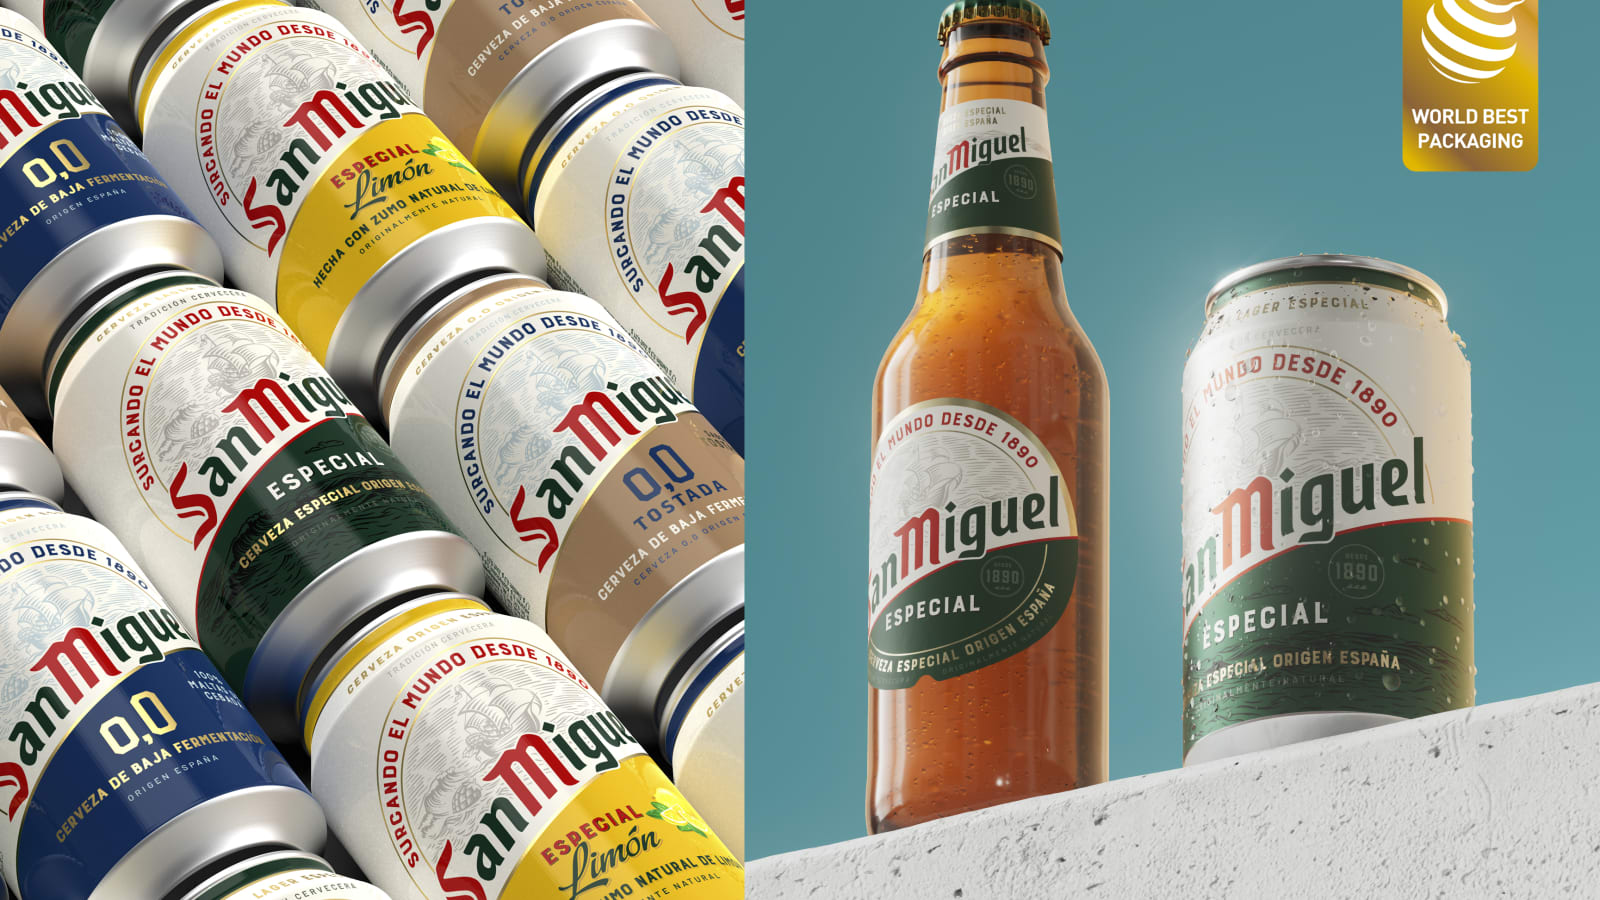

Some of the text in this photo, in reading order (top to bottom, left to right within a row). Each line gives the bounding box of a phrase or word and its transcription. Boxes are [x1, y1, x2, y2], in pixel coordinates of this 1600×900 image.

[217, 30, 273, 75] MUNDO
[277, 24, 336, 40] DESDE
[467, 27, 512, 77] CERVEZA
[512, 15, 530, 31] DE
[205, 82, 223, 100] EL
[22, 138, 91, 188] 0,0
[200, 108, 230, 207] SURCANDO
[330, 143, 420, 190] ESPECIAL
[560, 121, 608, 169] CERVEZA
[29, 200, 49, 217] DE
[49, 182, 86, 204] BAJA
[46, 201, 83, 225] ORIGEN
[86, 188, 127, 203] ESPAÑA
[344, 158, 434, 221] Limón
[610, 109, 743, 293] SURCANDO EL MUNDO DESDE
[931, 190, 1000, 218] ESPECIAL
[312, 248, 345, 289] HECHA
[344, 223, 370, 248] CON
[370, 199, 407, 226] ZUMO
[408, 183, 465, 203] NATURAL
[466, 183, 480, 192] DE
[359, 195, 484, 255] ORIGINALMENTE NATURAL
[96, 302, 151, 343] CERVEZA
[129, 298, 187, 330] TRADICIÓN
[150, 308, 213, 352] MUNDO
[217, 305, 276, 328] DESDE
[464, 312, 511, 345] TRADICIÓN
[541, 314, 602, 331] DESDE
[1236, 296, 1369, 321] LAGER ESPECIAL
[135, 357, 157, 377] EL
[415, 325, 464, 376] CERVEZA
[478, 322, 536, 372] MUNDO
[465, 379, 485, 400] EL
[1202, 355, 1262, 403] MUNDO
[1272, 353, 1347, 385] DESDE
[1350, 379, 1398, 428] 1890
[126, 385, 155, 491] SURCANDO
[460, 408, 494, 515] SURCANDO
[887, 413, 934, 450] MUNDO
[941, 411, 998, 436] DESDE
[1001, 431, 1039, 468] 1890
[266, 451, 385, 501] ESPECIAL
[622, 444, 695, 502] 0,0
[238, 517, 295, 569] CERVEZA
[293, 485, 361, 520] ESPECIAL
[361, 478, 406, 491] ORIGEN
[633, 480, 728, 531] TOSTADA
[30, 543, 97, 561] DESDE
[105, 557, 149, 590] 1890
[597, 548, 649, 601] CERVEZA
[648, 531, 669, 550] DE
[668, 510, 707, 535] BAJA
[633, 547, 678, 586] CERVEZA
[701, 515, 740, 535] ORIGEN
[1335, 562, 1378, 582] 1890
[986, 568, 1020, 585] 1890
[885, 594, 980, 632] ESPECIAL
[896, 650, 960, 673] ESPECIAL
[964, 623, 1017, 656] ORIGEN
[1019, 582, 1056, 627] ESPAÑA
[1203, 601, 1329, 650] ESPECIAL
[347, 644, 402, 695] CERVEZA
[406, 616, 458, 643] ORIGEN
[386, 621, 495, 679] TRADICIÓN CERVECERA
[1206, 656, 1267, 688] ESPECIAL
[1273, 649, 1333, 668] ORIGEN
[1339, 649, 1400, 671] ESPAÑA
[99, 690, 178, 755] 0,0
[127, 754, 219, 802] ORIGEN ESPAÑA
[383, 642, 589, 868] SURCANDO EL MUNDO DESDE 1890
[55, 731, 264, 843] CERVEZA DE BAJA FERMENTACIÓN
[540, 805, 644, 867] ESPECIAL
[558, 825, 662, 900] Limón
[634, 856, 698, 888] NATURAL
[697, 855, 716, 866] DE
[672, 872, 721, 891] NATURAL
[252, 878, 300, 899] LAGER
[294, 882, 357, 900] CERVECERA
